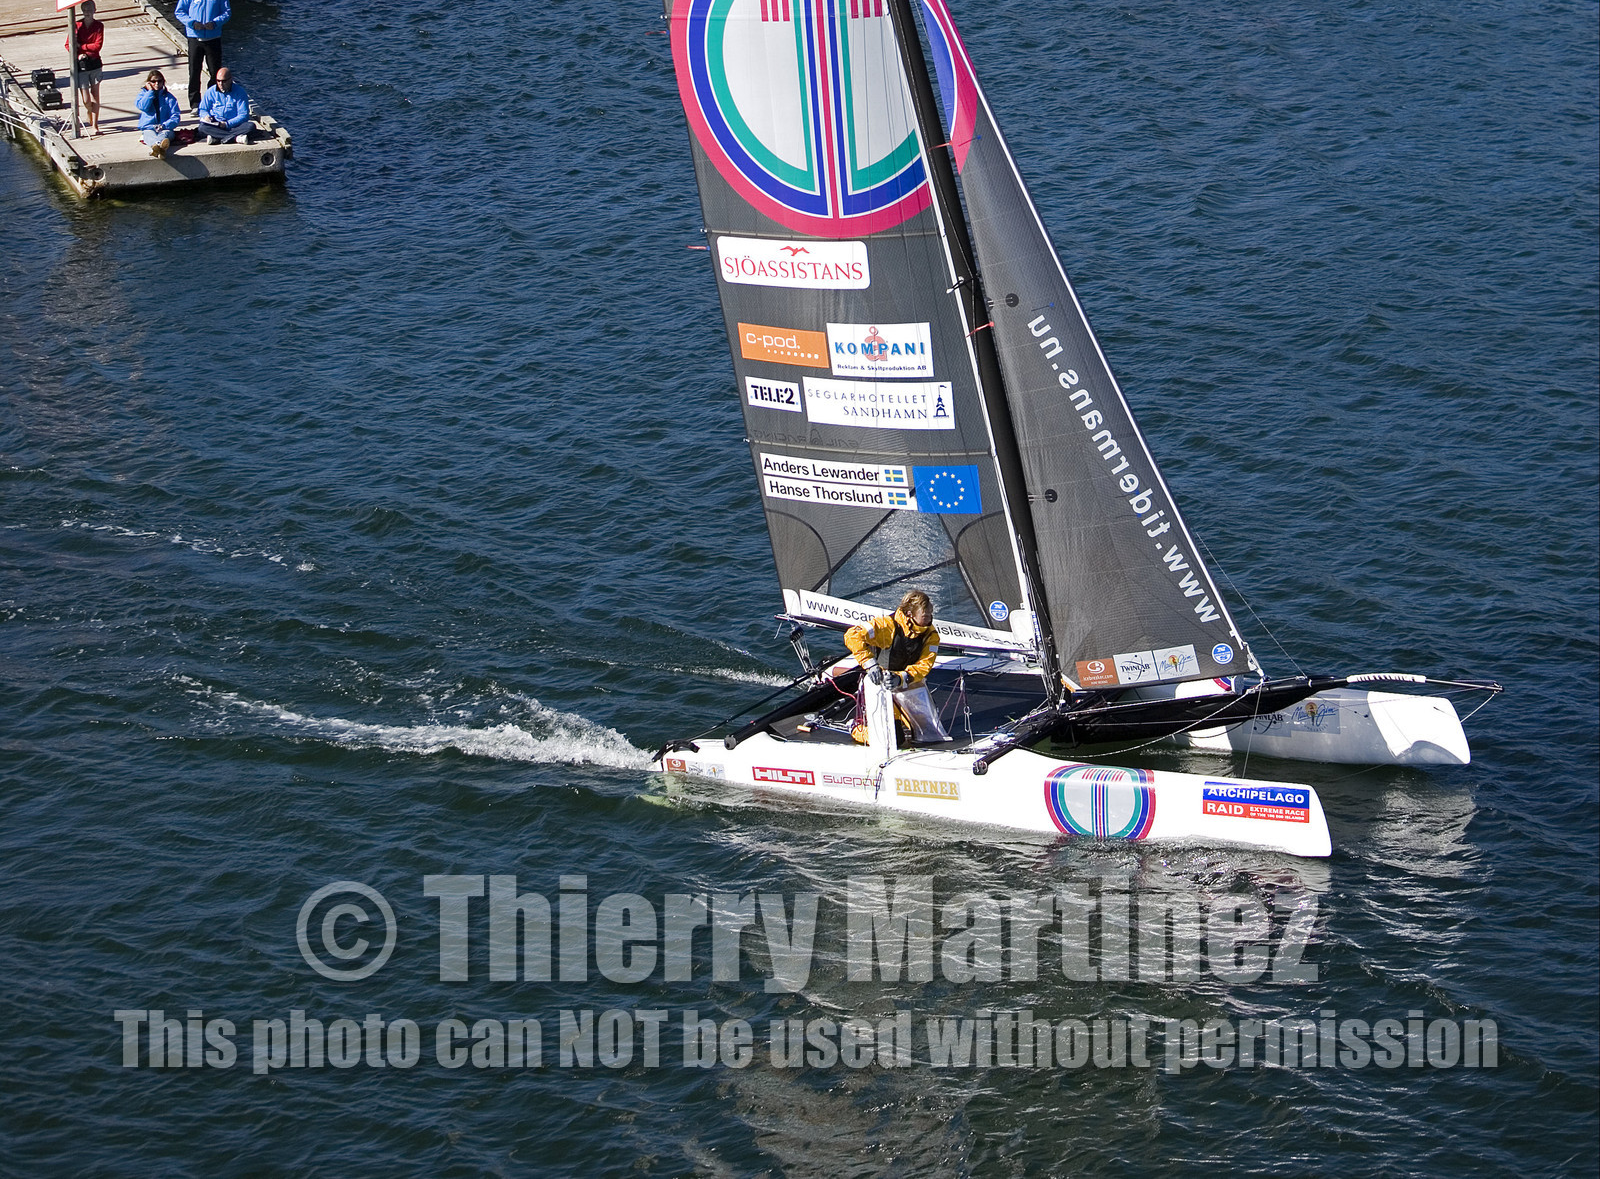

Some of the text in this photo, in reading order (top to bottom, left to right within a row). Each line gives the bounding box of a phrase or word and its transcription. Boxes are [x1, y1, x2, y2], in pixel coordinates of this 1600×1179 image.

[724, 256, 863, 280] SJÖASSISTANS
[835, 342, 925, 356] KOMPANI
[751, 385, 796, 405] TELE2
[807, 388, 927, 404] SEGLARHOTELLET
[843, 406, 928, 419] SANDHAMN
[764, 457, 880, 482] Anders Lewander
[769, 481, 883, 504] Hanse Thorslund
[1120, 663, 1151, 673] TWINLAB
[755, 769, 813, 785] HILTI
[896, 778, 959, 796] PARTNER
[1207, 787, 1305, 804] ARCHIPELAGO
[1206, 803, 1244, 815] RAID
[1249, 806, 1284, 814] EXTREME
